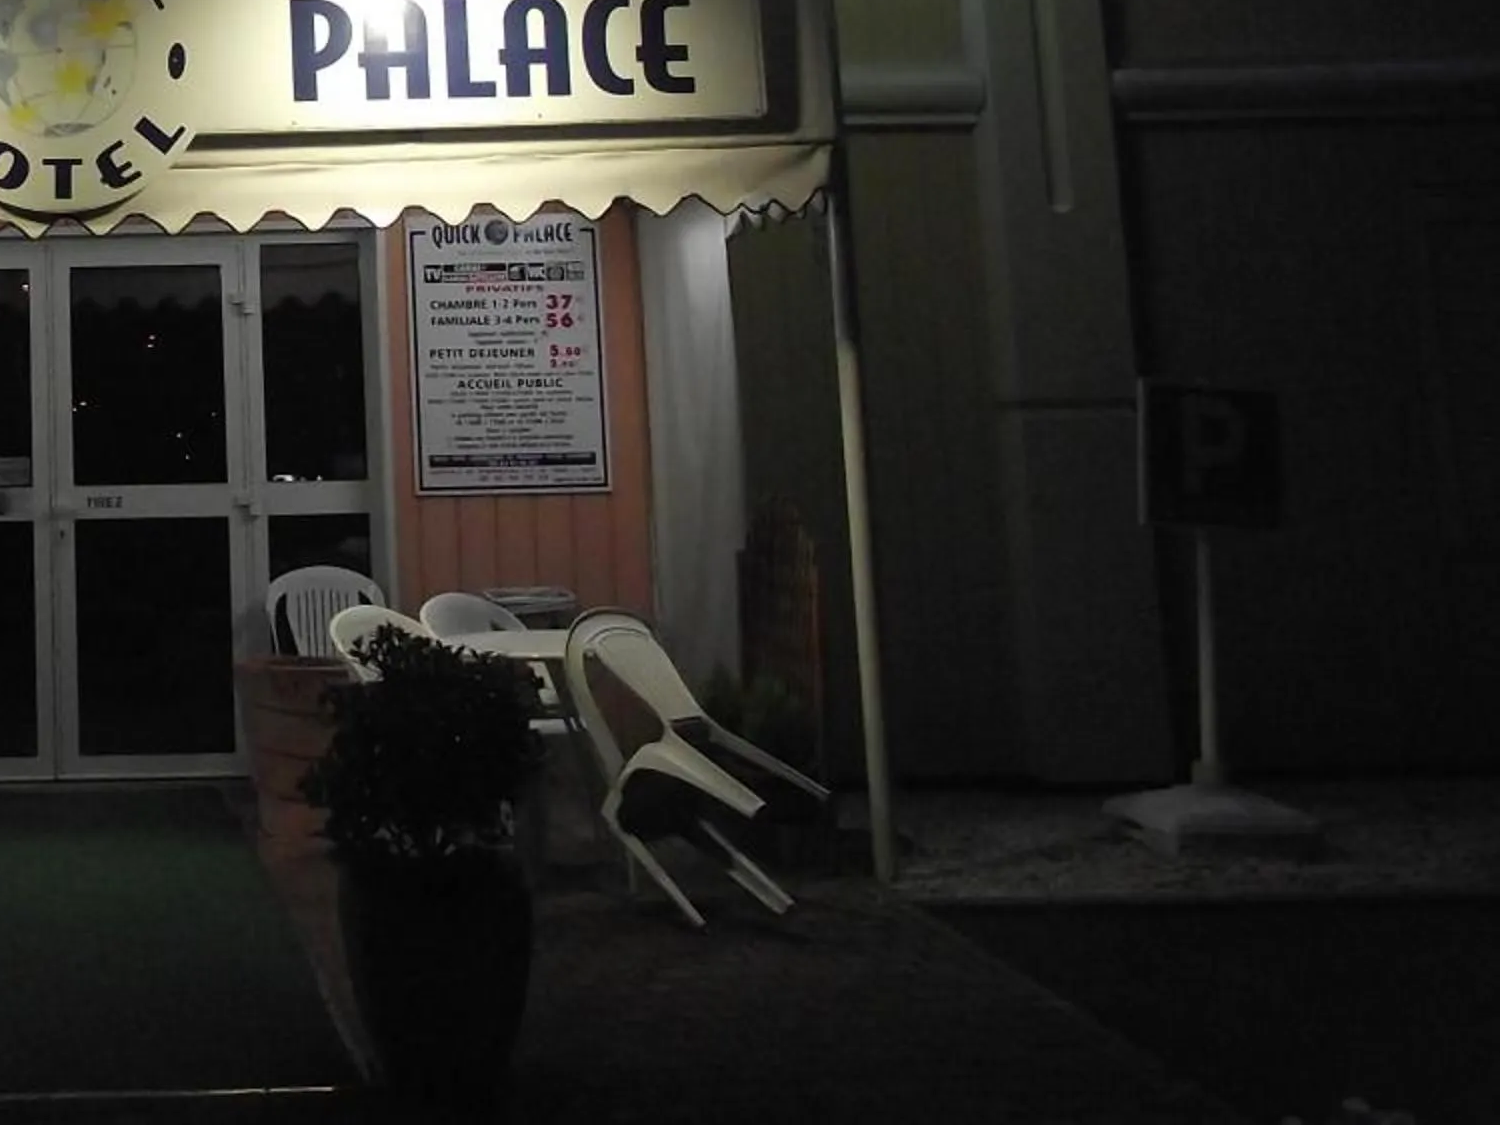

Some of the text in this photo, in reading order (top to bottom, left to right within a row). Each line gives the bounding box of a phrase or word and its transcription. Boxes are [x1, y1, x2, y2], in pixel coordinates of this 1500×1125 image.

[432, 224, 481, 248] QUICK
[430, 299, 487, 310] CHAMBRE
[546, 294, 573, 310] 37
[430, 315, 490, 326] FAMILIALE
[546, 312, 574, 328] 56
[429, 348, 464, 359] PETIT
[469, 348, 535, 359] DEJEUNER
[457, 378, 564, 389] ACCUEIL PUBLIC
[1180, 394, 1246, 494] P
